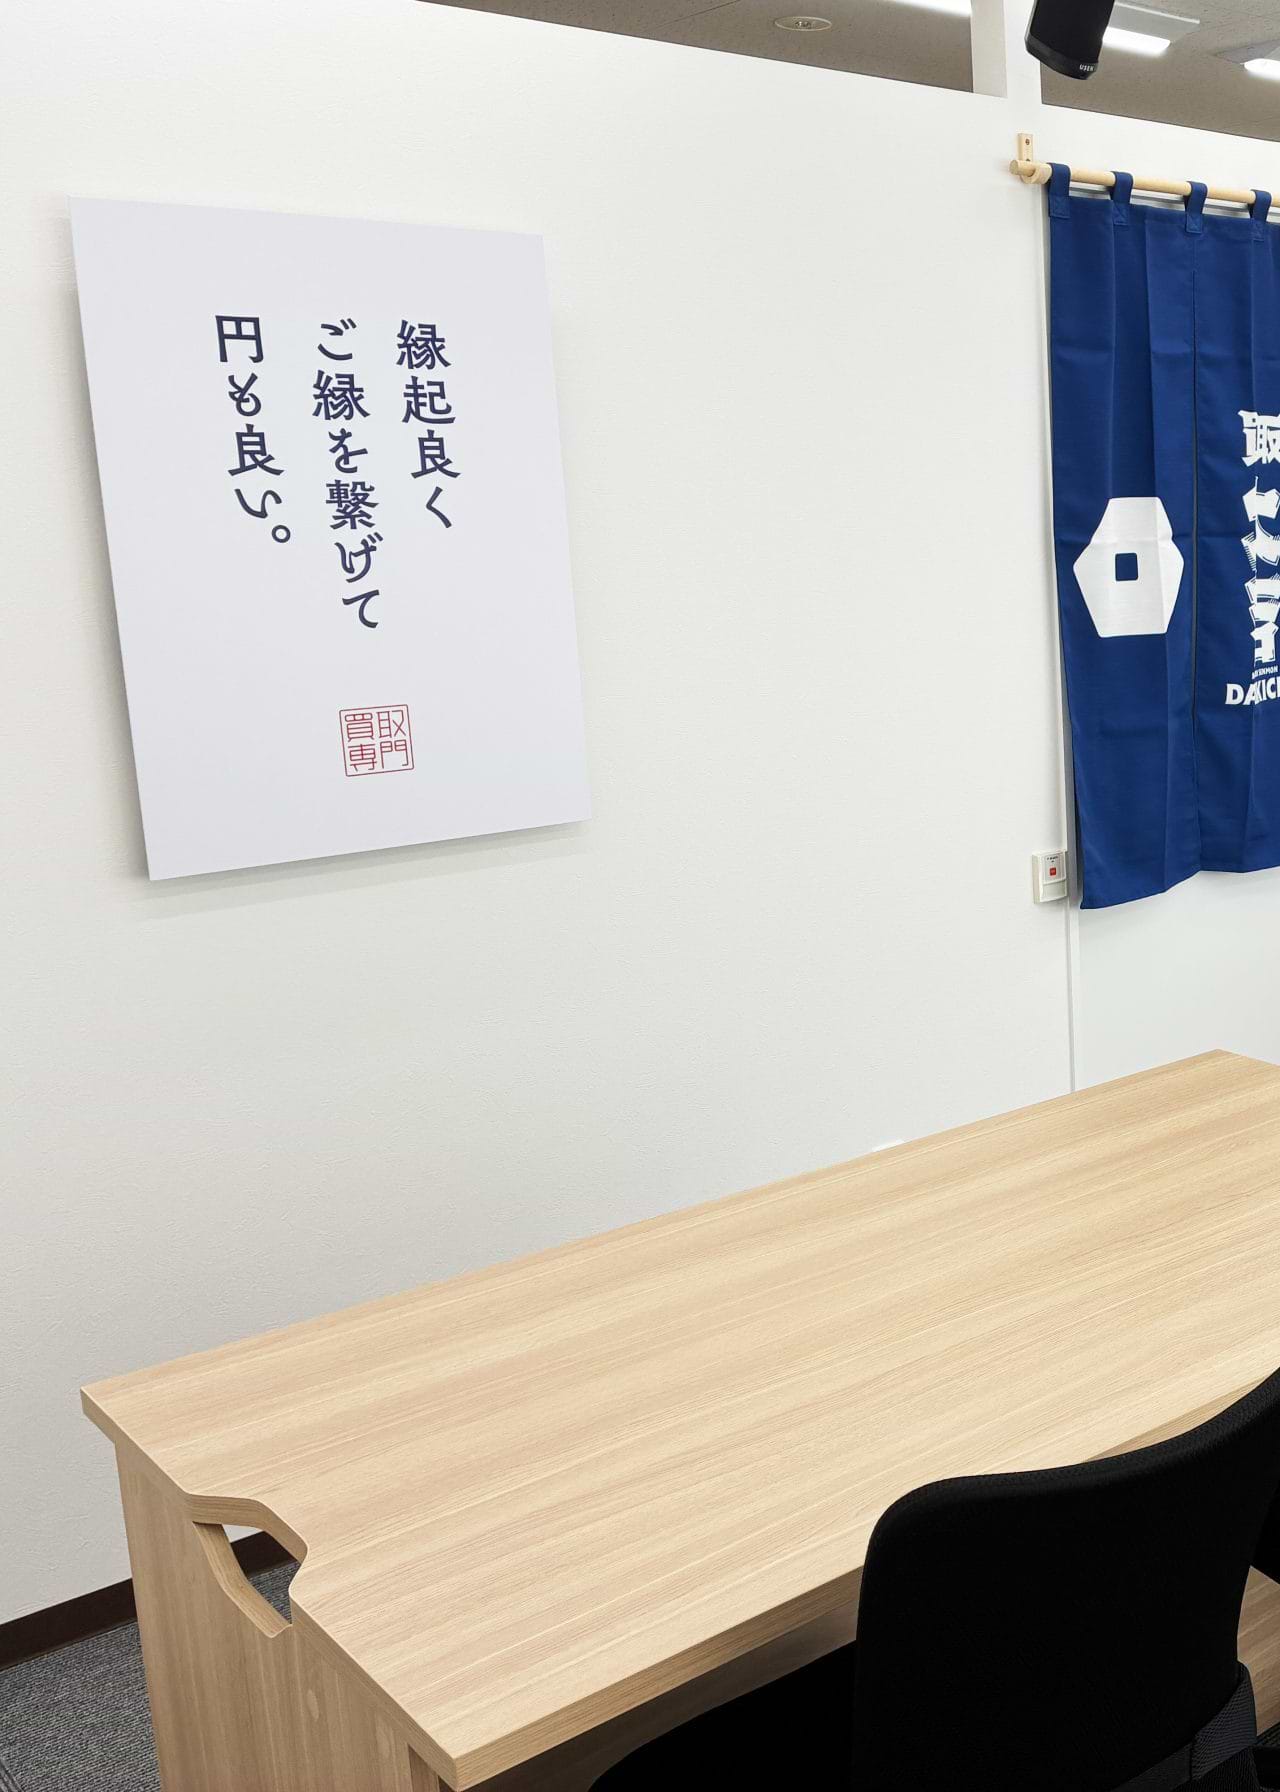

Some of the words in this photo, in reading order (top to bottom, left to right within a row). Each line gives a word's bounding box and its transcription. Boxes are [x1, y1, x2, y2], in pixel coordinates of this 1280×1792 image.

[214, 314, 291, 544] 円も良い。
[311, 317, 384, 629] ご縁を繋げて
[395, 318, 462, 529] 縁起良く
